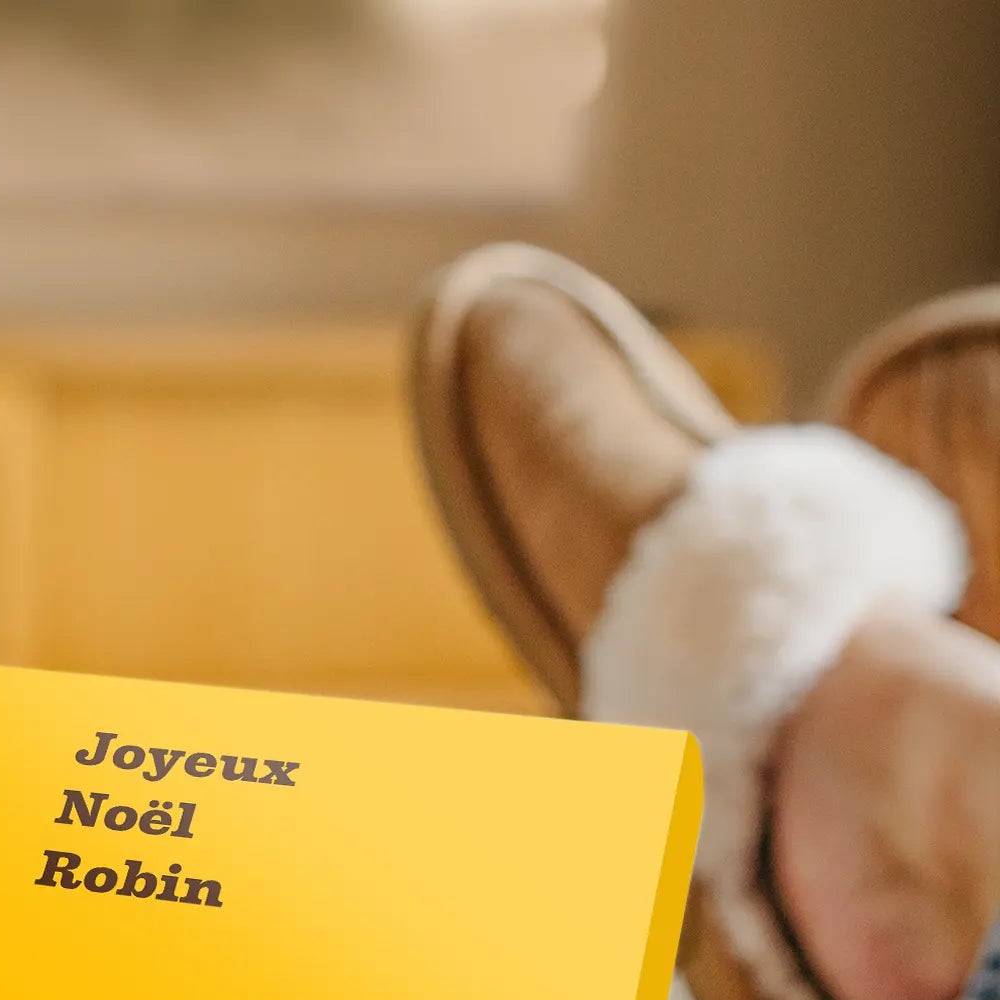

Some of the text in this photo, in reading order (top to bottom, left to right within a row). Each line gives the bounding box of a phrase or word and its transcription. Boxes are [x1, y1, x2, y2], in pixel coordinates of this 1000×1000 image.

[74, 732, 300, 787] Joyeux
[54, 790, 197, 839] Noël
[34, 850, 224, 908] Robin
